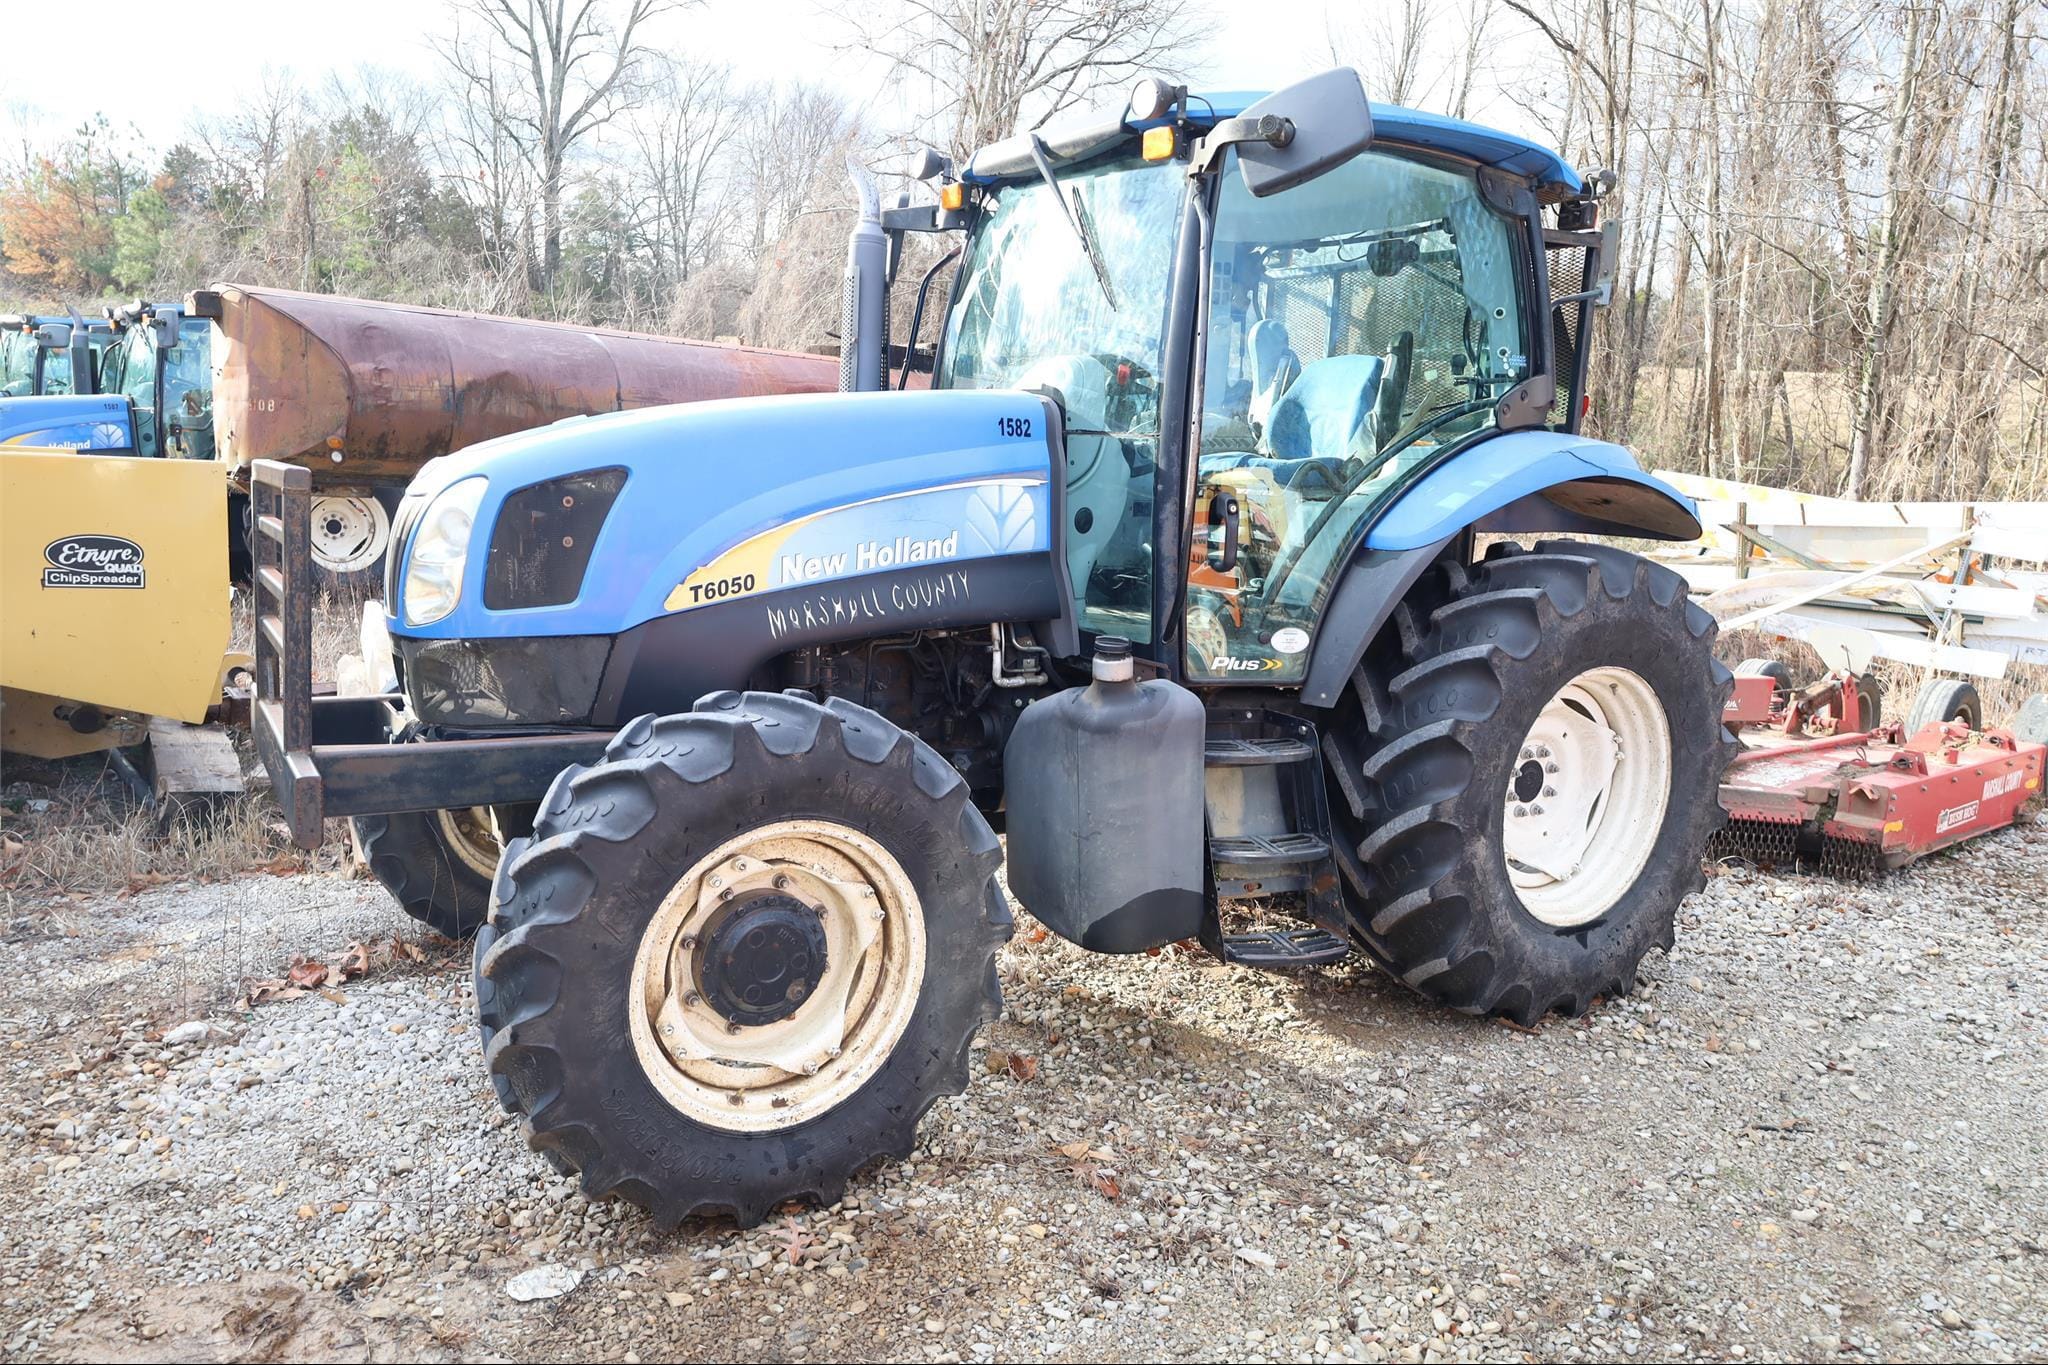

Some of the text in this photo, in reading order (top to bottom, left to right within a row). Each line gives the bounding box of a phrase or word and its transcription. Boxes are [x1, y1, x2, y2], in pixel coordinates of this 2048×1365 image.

[998, 417, 1032, 438] 1582
[58, 543, 133, 567] Etnyre
[780, 529, 958, 584] New Holland
[49, 573, 139, 585] ChipSpreader
[103, 563, 144, 574] QUAD
[689, 573, 756, 603] T6050
[891, 569, 970, 612] COUNTY
[1210, 656, 1261, 671] Plus
